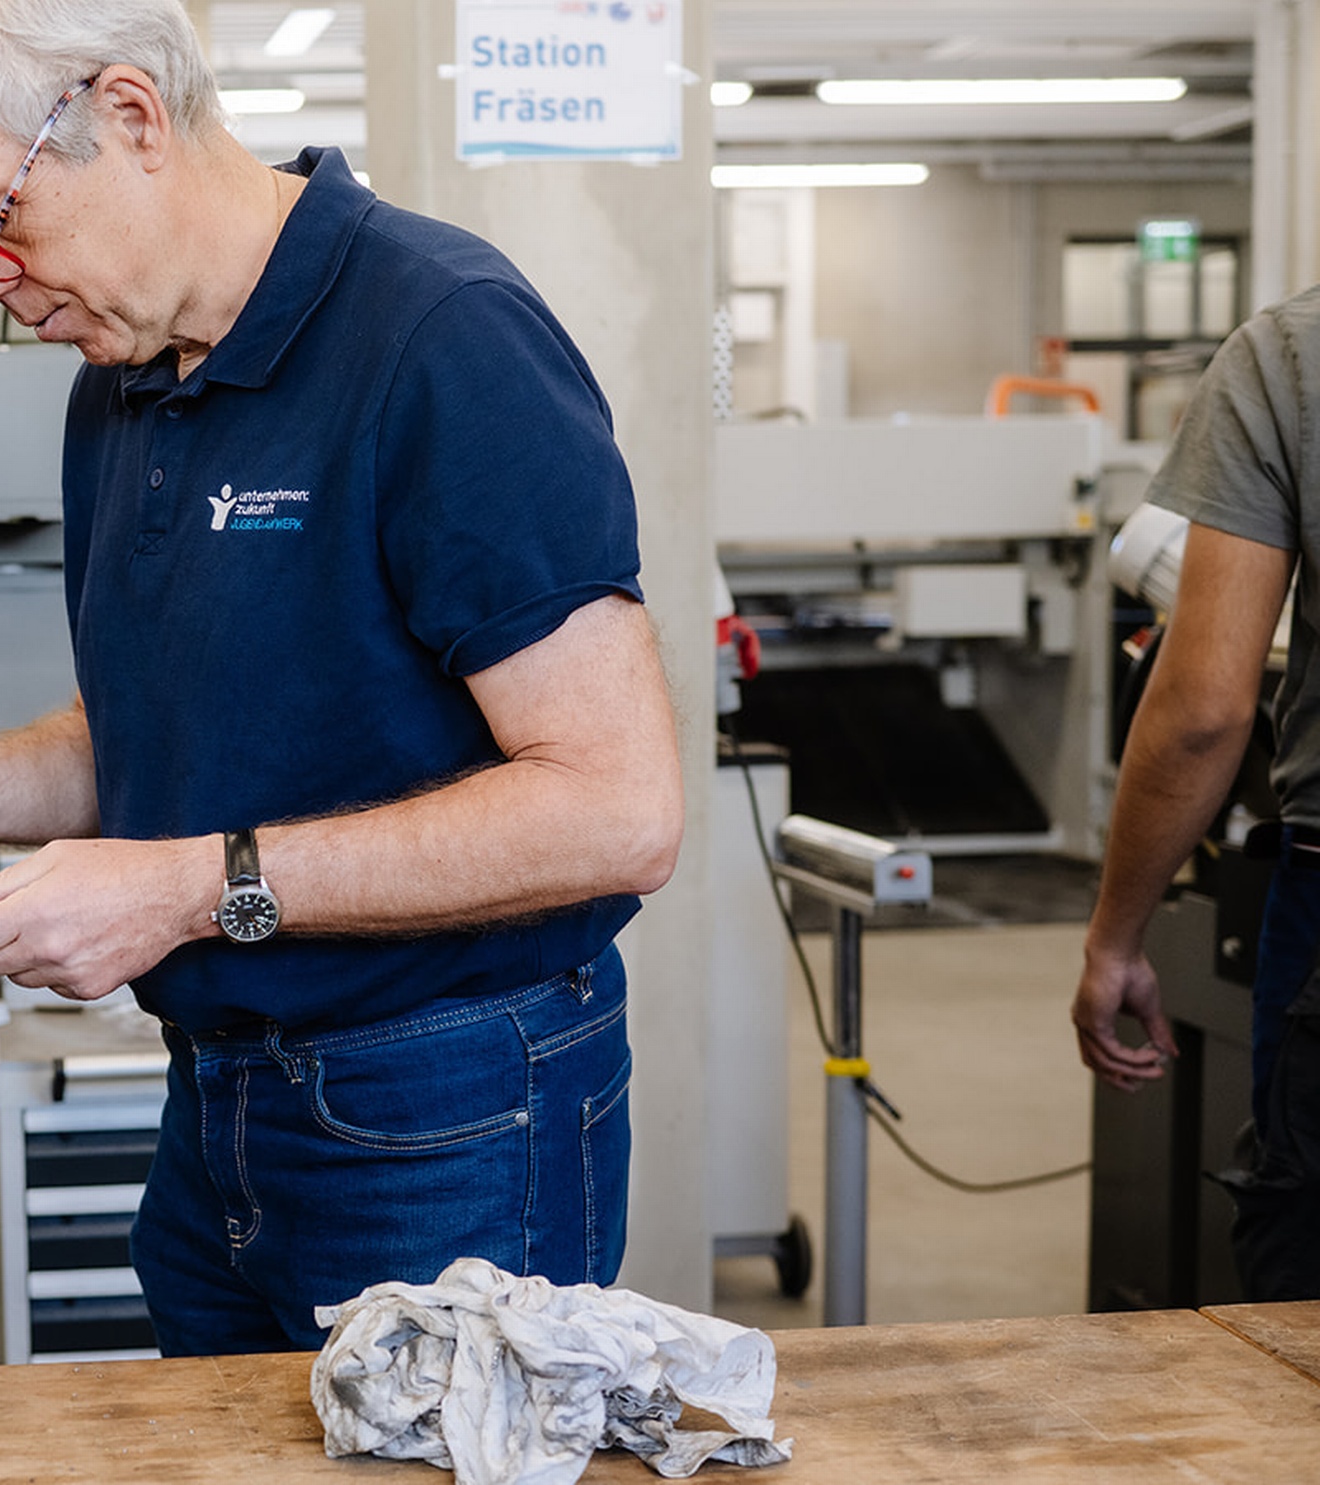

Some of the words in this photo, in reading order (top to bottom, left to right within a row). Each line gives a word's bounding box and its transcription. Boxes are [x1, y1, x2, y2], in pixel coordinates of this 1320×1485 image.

[472, 34, 606, 67] Station
[473, 89, 606, 122] Fräsen
[235, 502, 275, 515] zukunft
